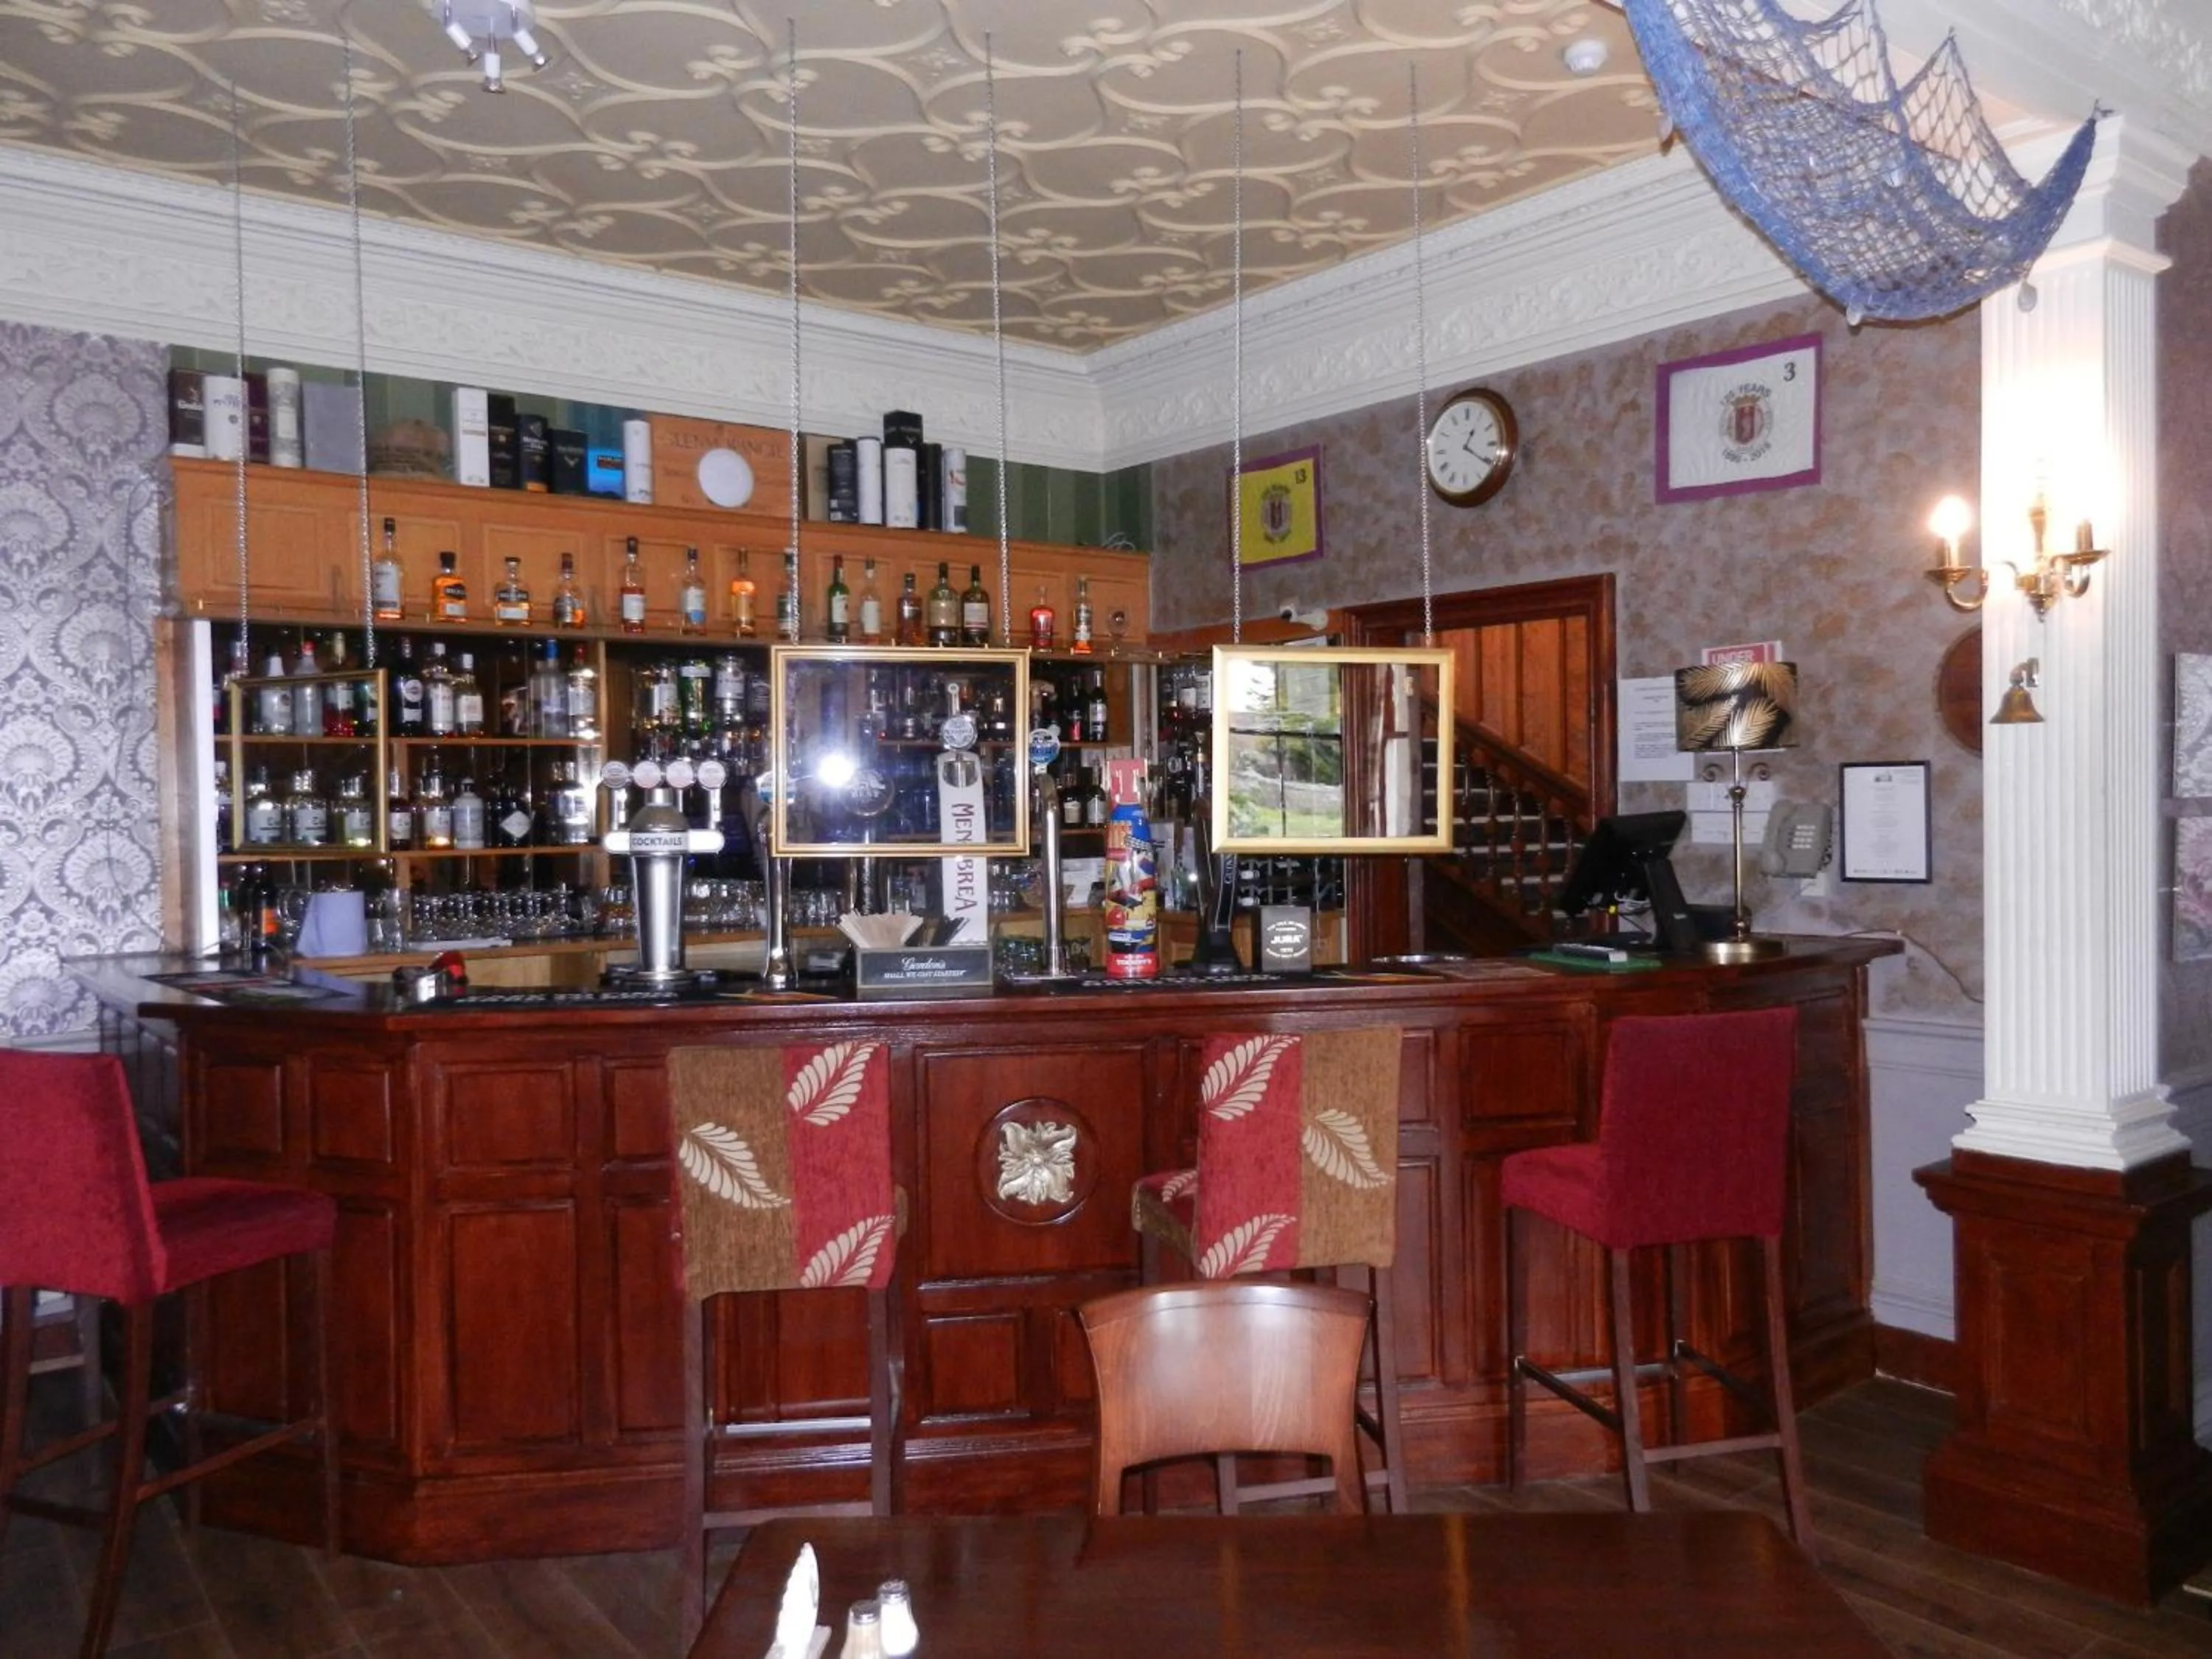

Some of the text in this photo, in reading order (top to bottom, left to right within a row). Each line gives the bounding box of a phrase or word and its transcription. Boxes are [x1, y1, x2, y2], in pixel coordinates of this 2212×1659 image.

[1783, 362, 1796, 381] 3
[1295, 467, 1307, 484] 13
[1711, 649, 1756, 664] UNDER
[631, 836, 684, 846] COCKTAILS
[950, 802, 978, 912] MENBREA
